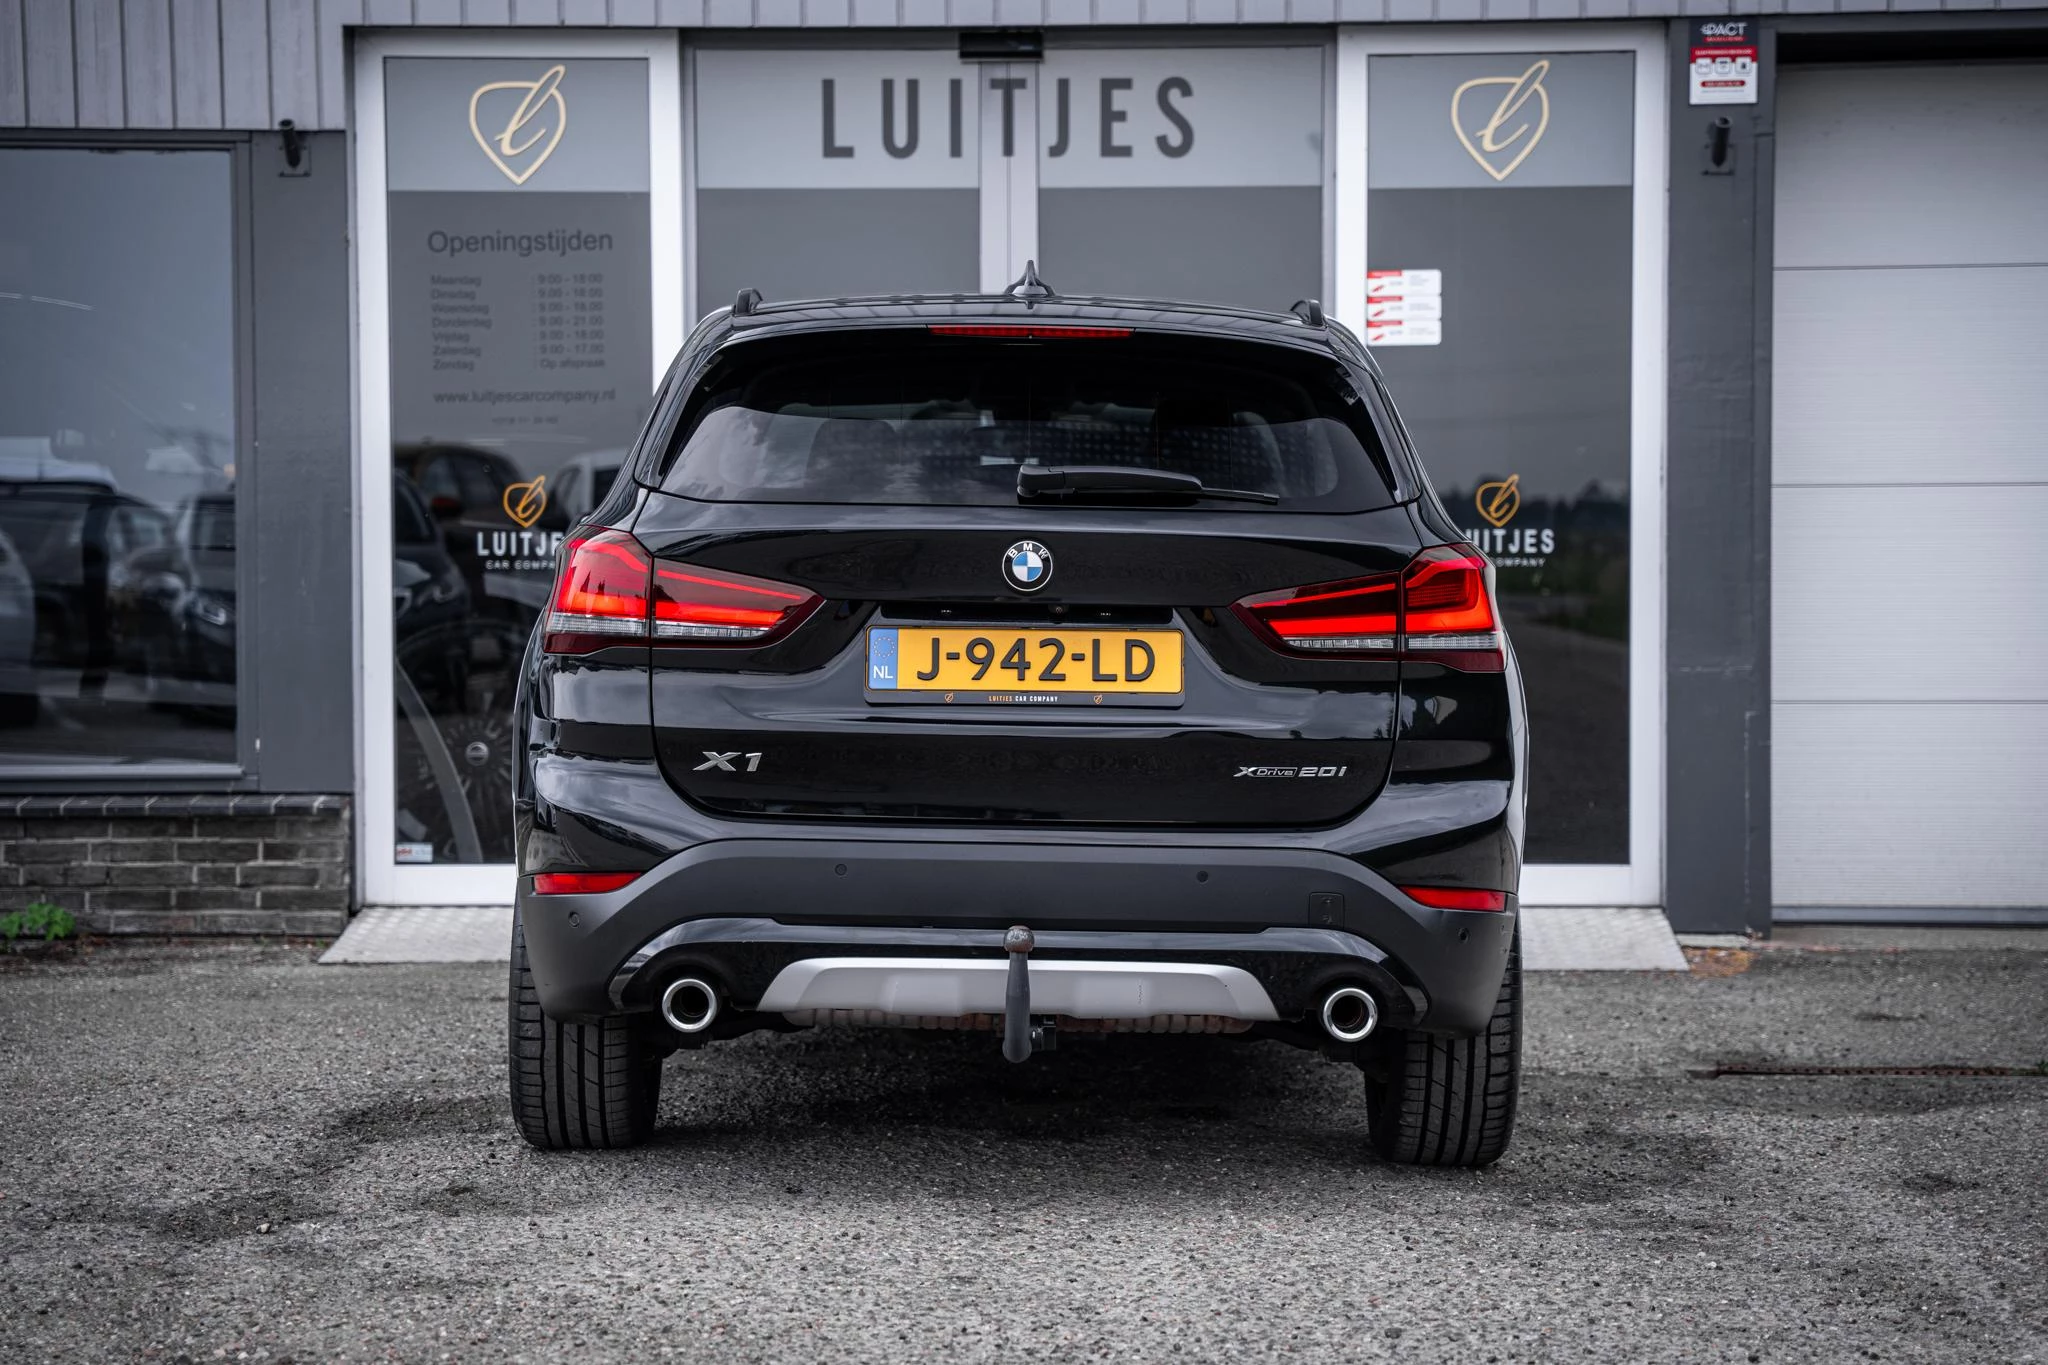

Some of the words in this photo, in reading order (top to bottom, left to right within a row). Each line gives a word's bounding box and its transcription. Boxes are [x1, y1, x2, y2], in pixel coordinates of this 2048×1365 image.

[821, 75, 1195, 160] LUITJES
[427, 229, 614, 257] Openingstijden
[433, 388, 616, 406] www.luitjescarcompany.nl
[476, 531, 565, 556] LUITJE
[1007, 543, 1050, 560] BMW
[1465, 528, 1555, 554] UITJES
[485, 560, 510, 570] CAR
[1490, 557, 1546, 567] OMPANY
[917, 638, 1156, 682] J-942-LD
[873, 666, 894, 680] NL
[692, 751, 763, 772] X1
